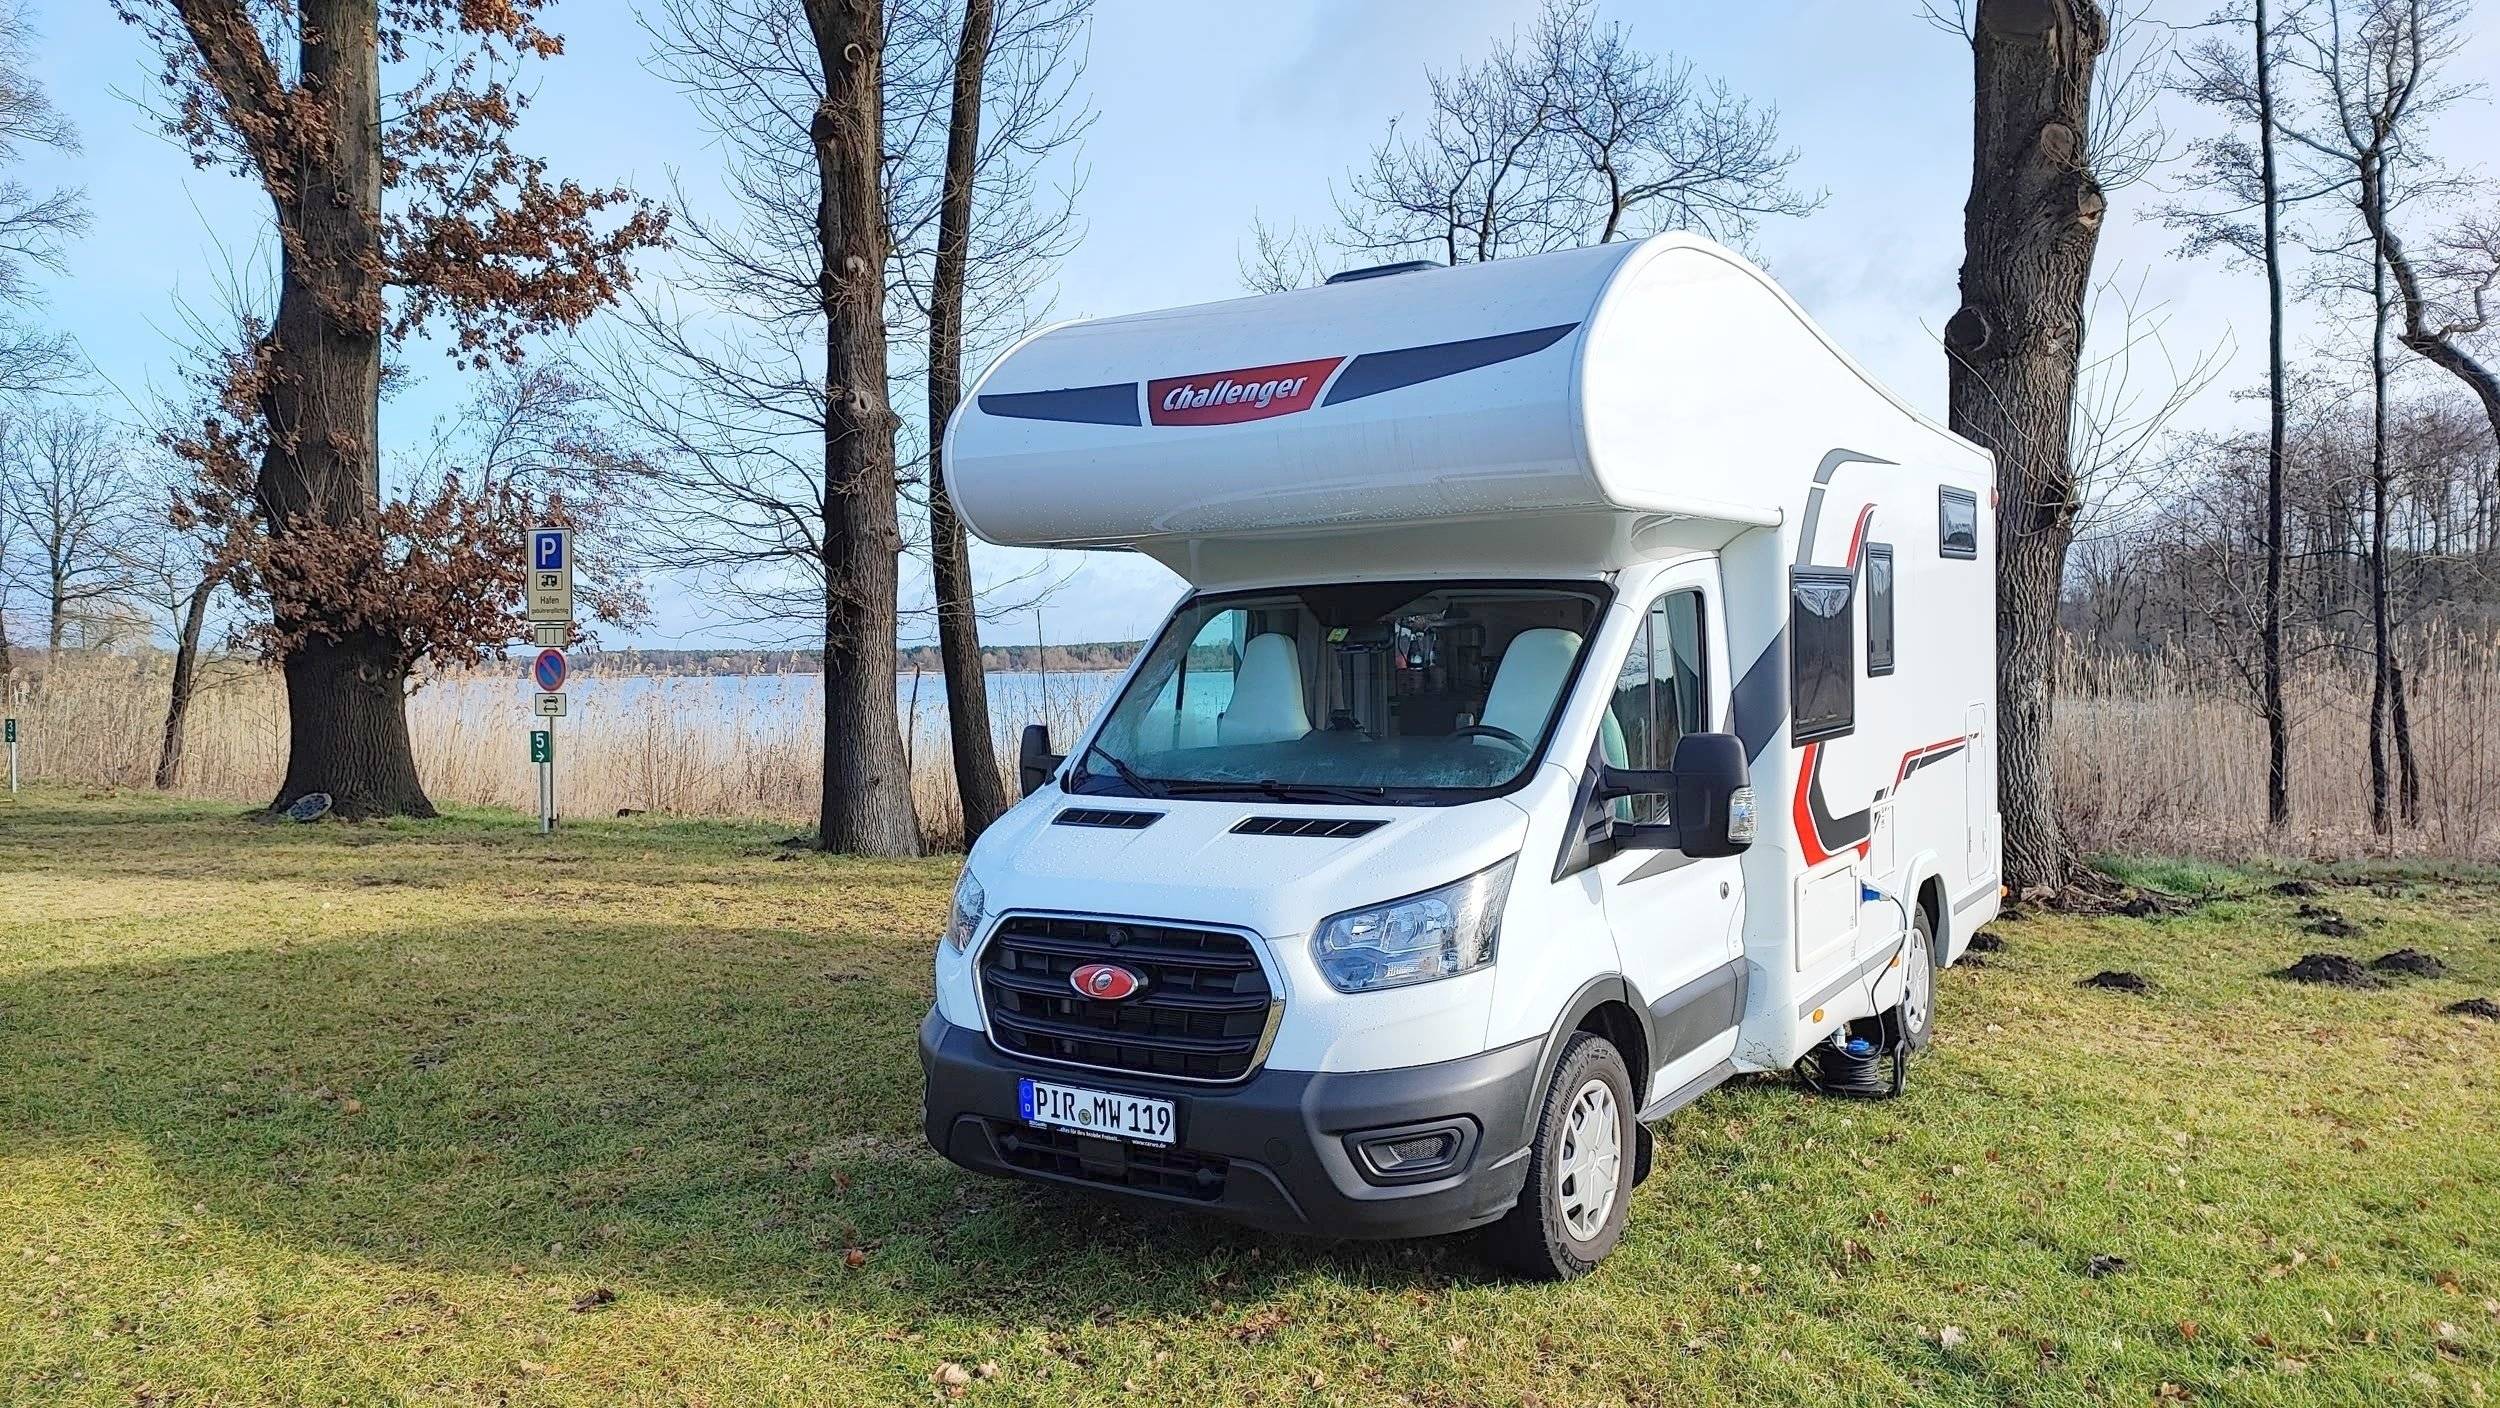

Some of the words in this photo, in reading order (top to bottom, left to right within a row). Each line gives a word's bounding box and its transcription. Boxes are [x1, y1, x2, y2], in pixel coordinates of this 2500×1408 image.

[1163, 376, 1308, 411] Challenger
[541, 537, 556, 565] P
[7, 720, 13, 732] 3
[536, 732, 545, 748] 5
[1035, 1087, 1076, 1121] PIR
[1093, 1097, 1121, 1129] MW
[1128, 1103, 1170, 1136] 119
